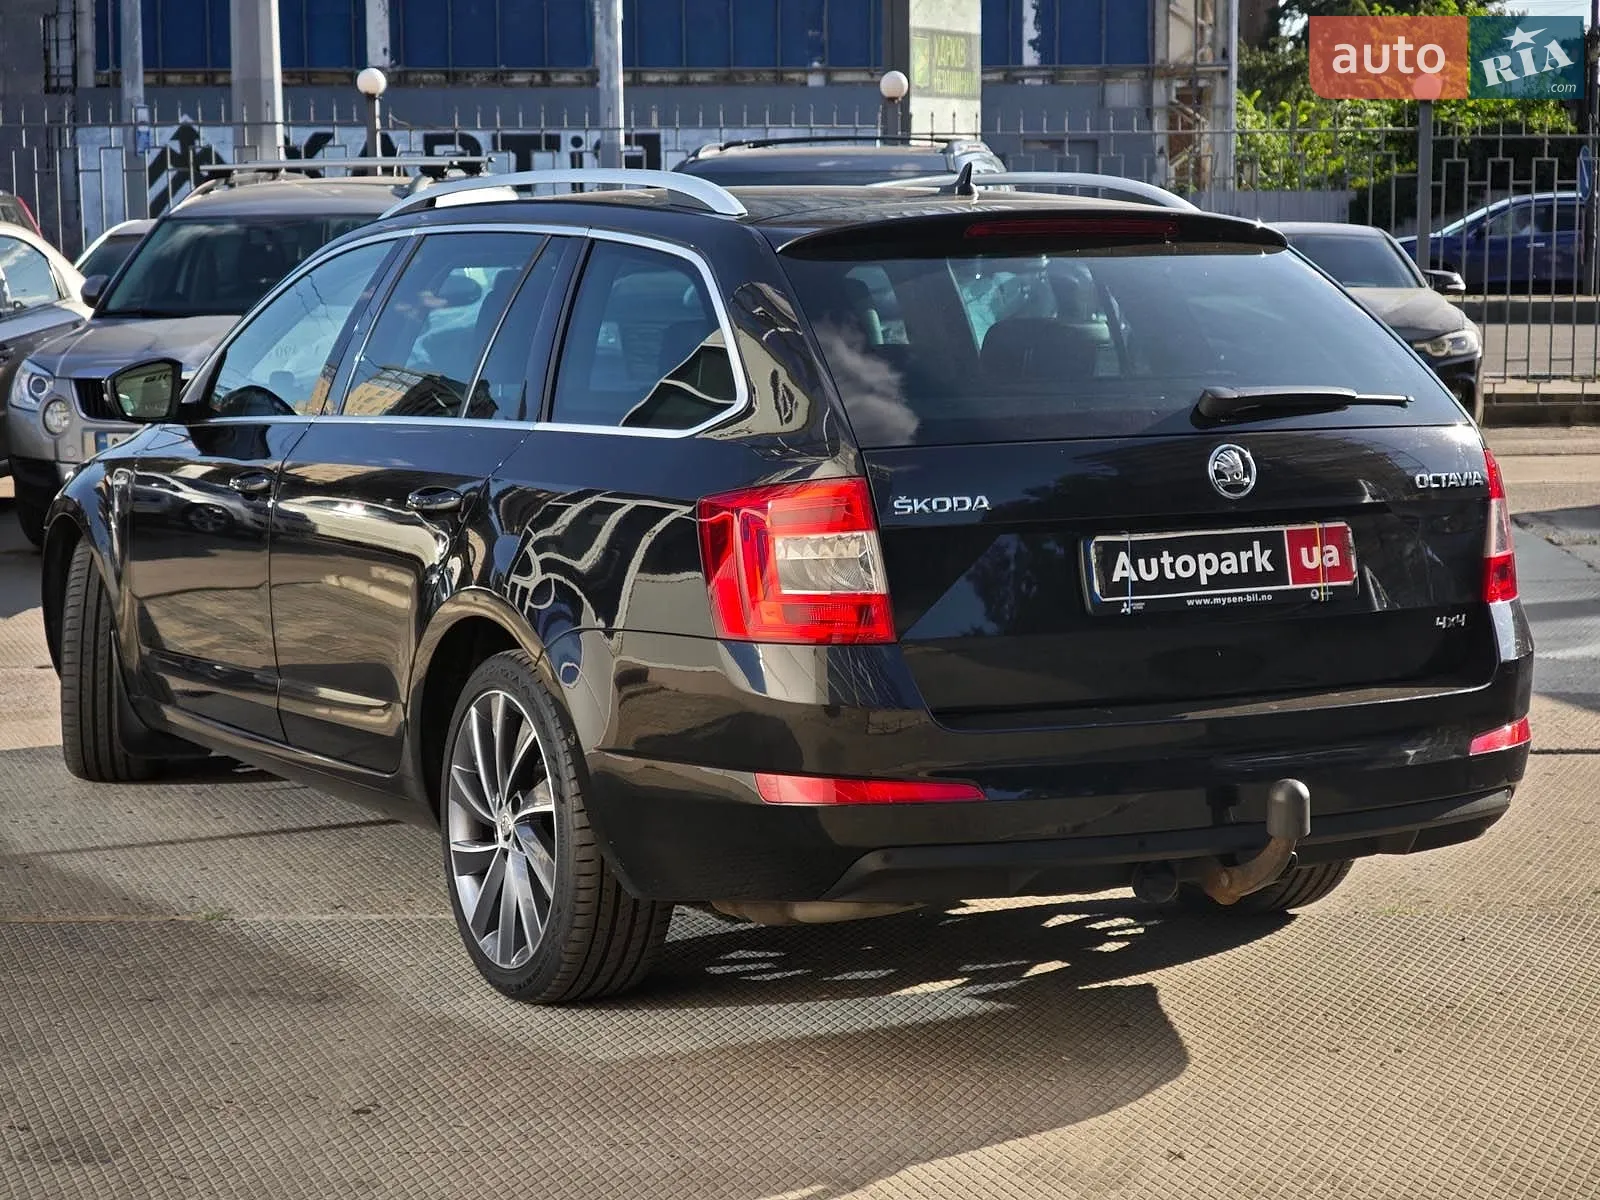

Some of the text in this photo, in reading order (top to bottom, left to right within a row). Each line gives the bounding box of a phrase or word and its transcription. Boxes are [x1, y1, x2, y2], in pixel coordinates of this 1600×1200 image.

[1414, 470, 1485, 489] OCTAVIA
[893, 494, 993, 516] ŠKODA
[1111, 540, 1341, 586] Autopark ua
[1186, 592, 1273, 607] www.mysen-bil.no
